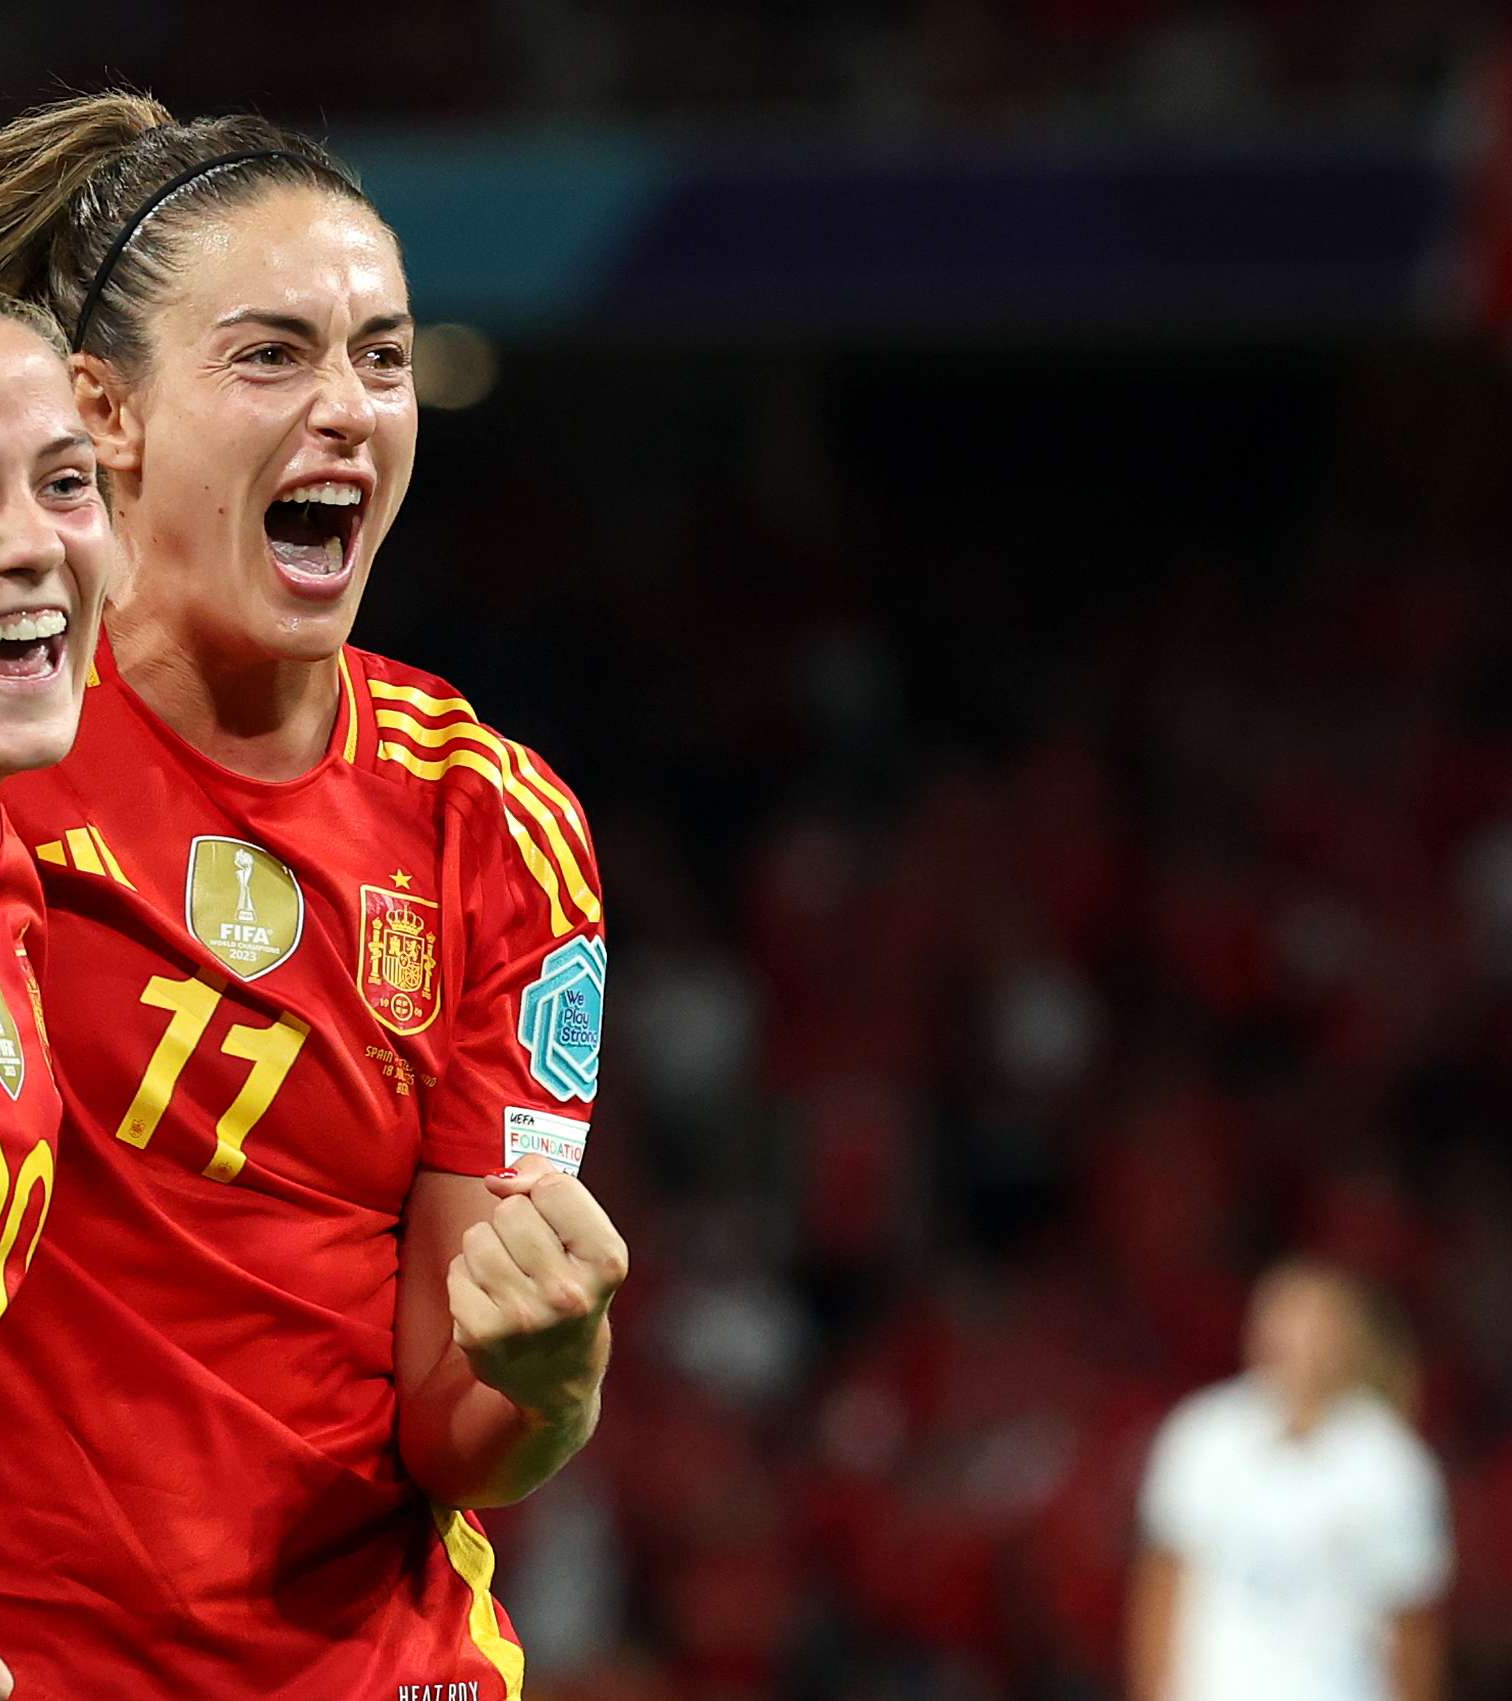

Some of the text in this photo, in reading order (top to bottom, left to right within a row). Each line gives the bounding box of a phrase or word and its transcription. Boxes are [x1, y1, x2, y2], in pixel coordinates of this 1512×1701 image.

[220, 923, 270, 945] FIFA
[229, 949, 257, 962] 2023
[565, 989, 584, 1006] We
[563, 1008, 590, 1029] Play
[364, 1045, 393, 1063] SPAIN
[116, 975, 311, 1183] 11
[510, 1112, 535, 1125] UEFA
[510, 1132, 582, 1162] FOUNDATIO
